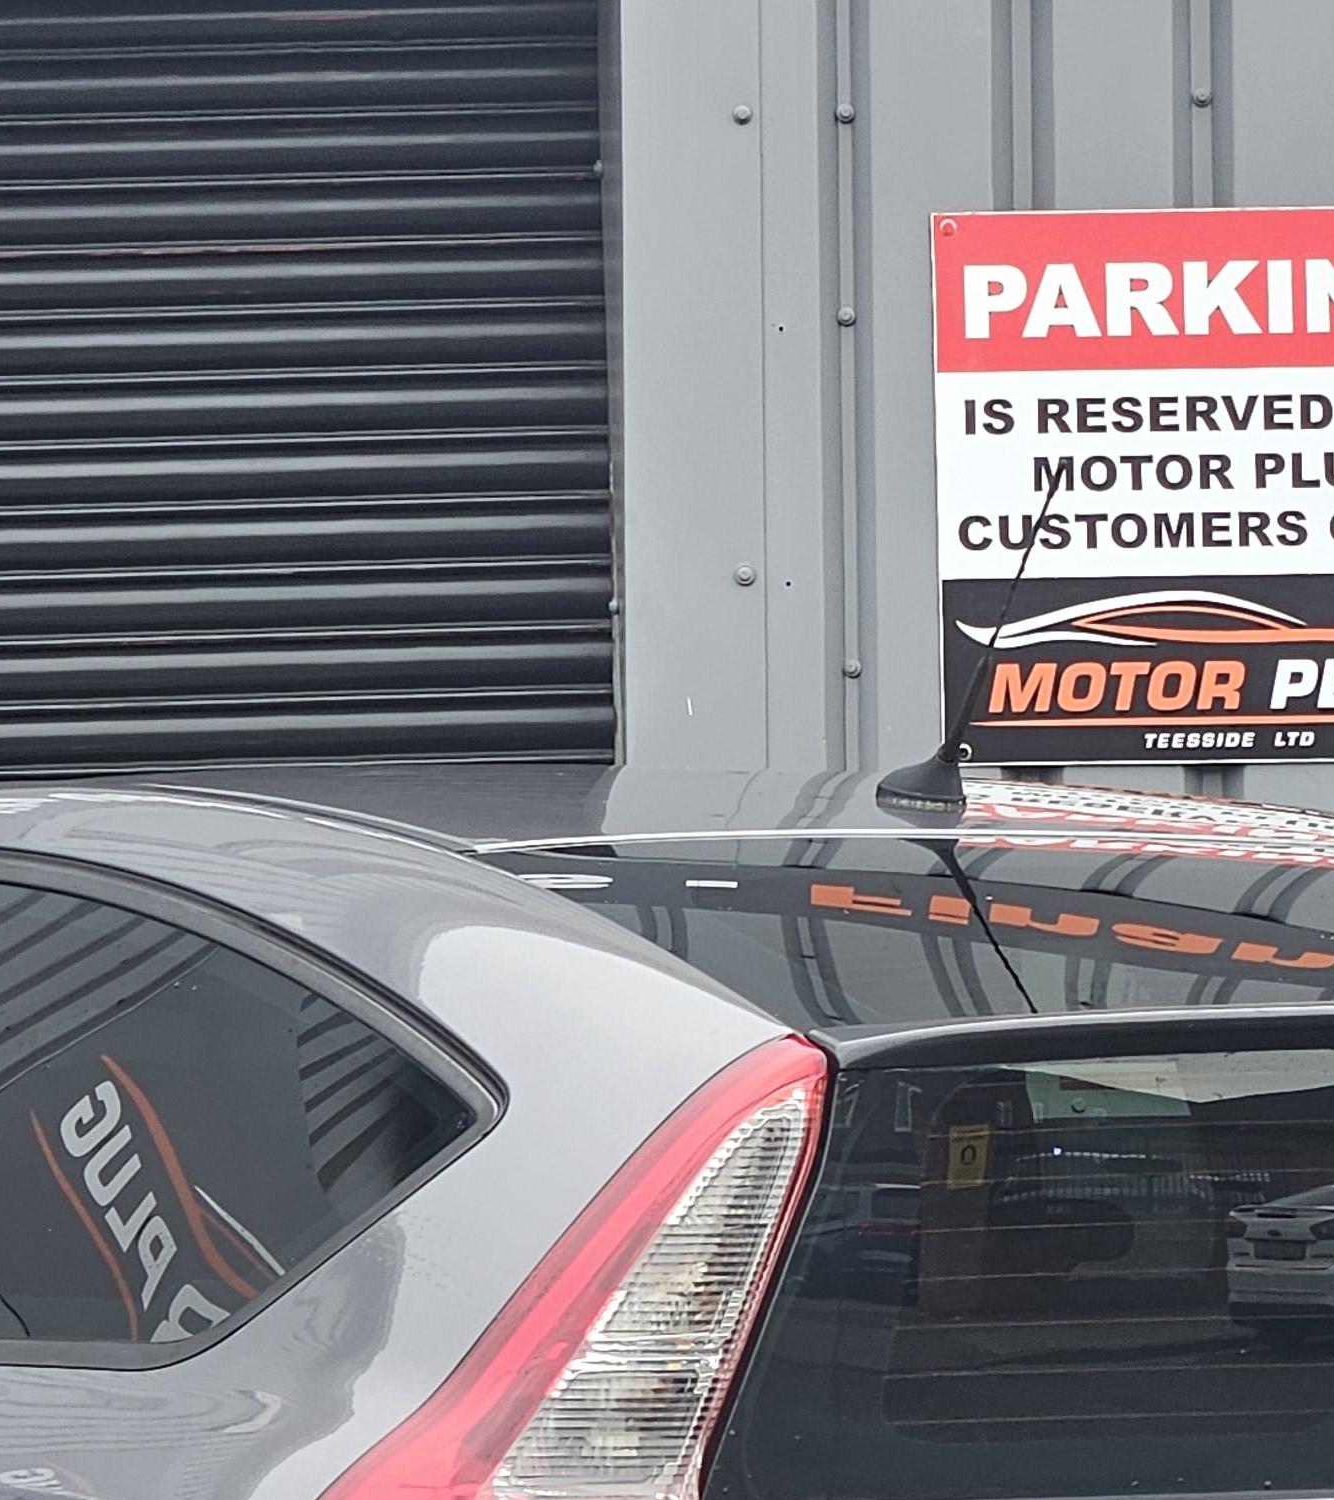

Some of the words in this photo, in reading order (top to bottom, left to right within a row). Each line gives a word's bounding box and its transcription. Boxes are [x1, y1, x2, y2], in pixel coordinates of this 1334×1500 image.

[964, 399, 1015, 435] IS
[1037, 394, 1333, 433] RESERVED
[1033, 453, 1233, 492] MOTOR
[958, 510, 1308, 551] CUSTOMERS
[988, 661, 1245, 713] MOTOR
[1144, 731, 1255, 749] TEESSIDE
[1273, 729, 1315, 748] LTD
